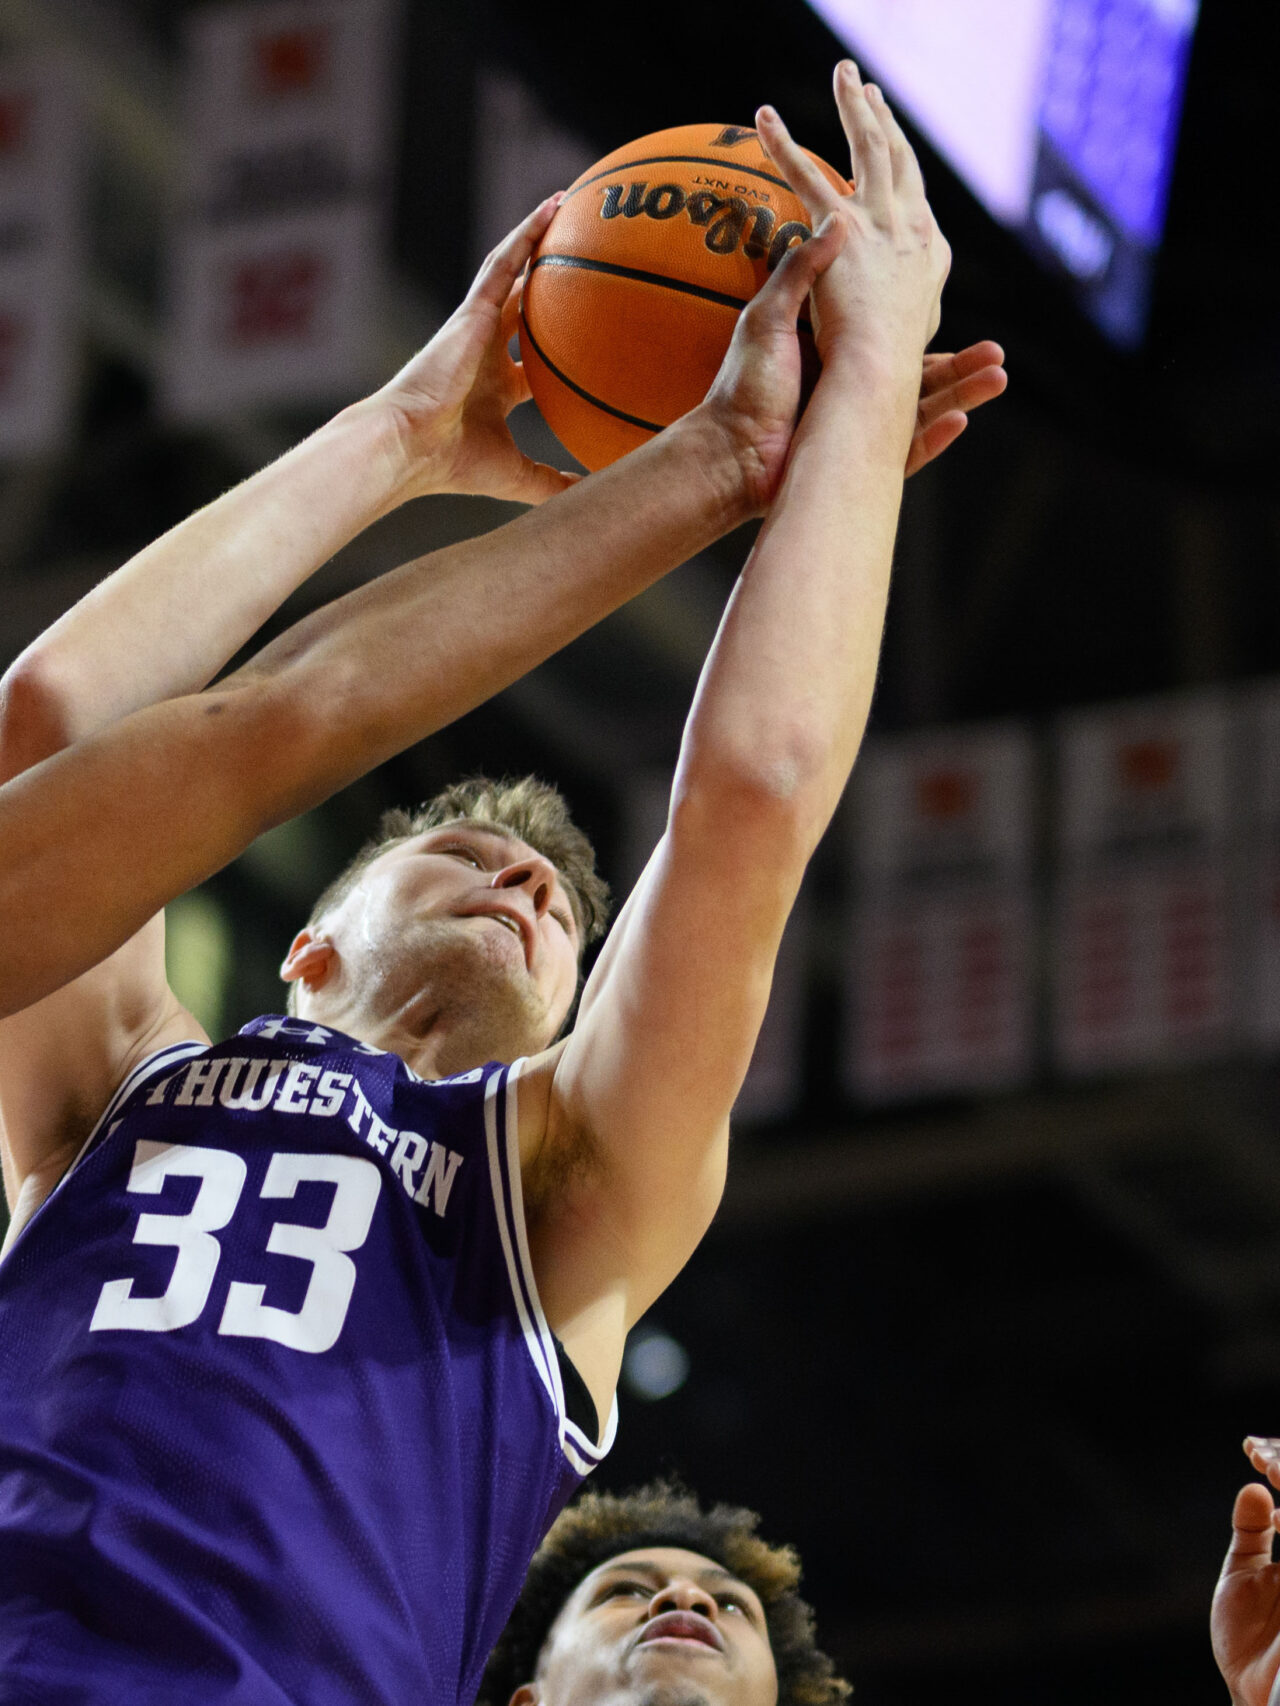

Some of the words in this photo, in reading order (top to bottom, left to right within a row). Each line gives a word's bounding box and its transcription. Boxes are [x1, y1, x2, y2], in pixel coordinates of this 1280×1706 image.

[692, 176, 729, 191] NXT
[734, 185, 770, 203] EVO
[89, 1139, 382, 1354] 33
